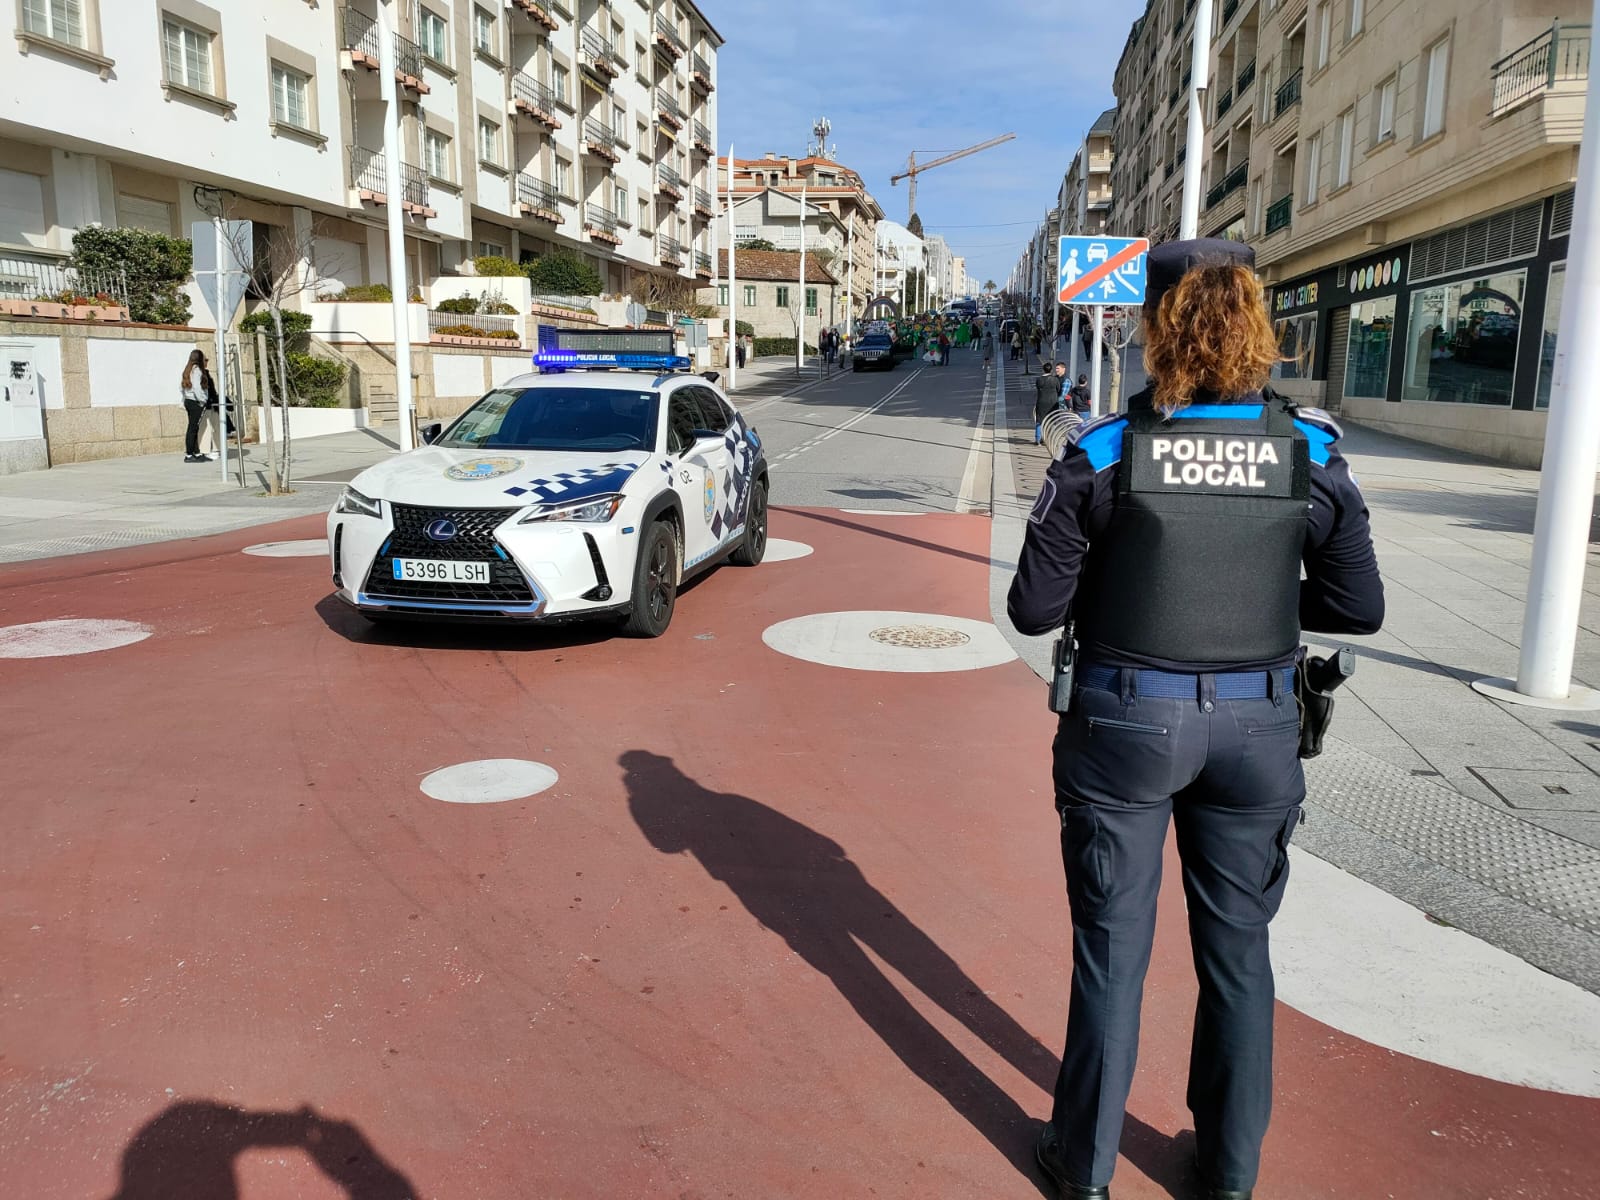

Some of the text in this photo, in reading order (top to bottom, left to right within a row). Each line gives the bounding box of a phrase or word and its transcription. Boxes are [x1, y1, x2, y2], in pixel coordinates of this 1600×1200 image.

[599, 354, 617, 362] LOCAL
[1152, 438, 1279, 464] POLICIA
[1163, 462, 1266, 487] LOCAL
[405, 561, 486, 581] 5396 LSH
